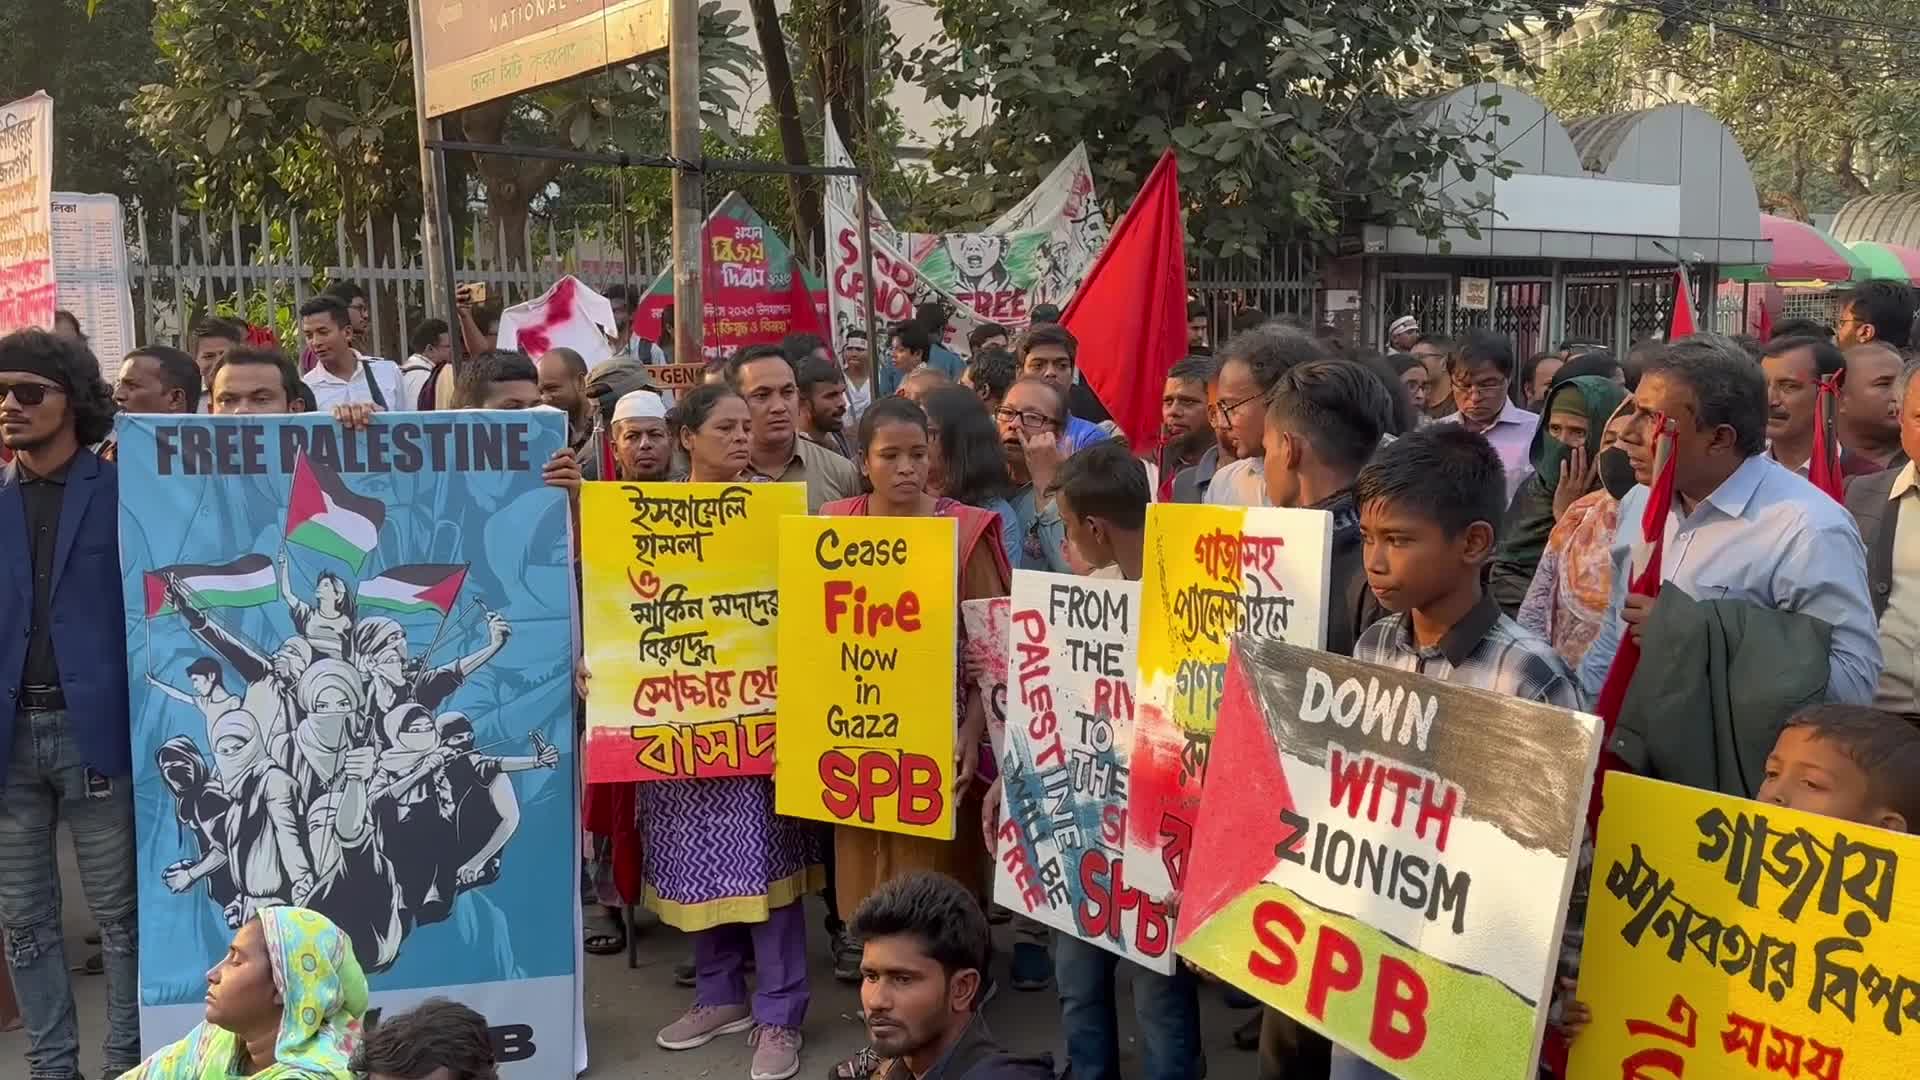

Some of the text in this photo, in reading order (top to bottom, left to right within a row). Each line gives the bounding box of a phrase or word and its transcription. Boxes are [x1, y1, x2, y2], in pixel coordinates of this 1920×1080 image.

[489, 0, 567, 32] NATIONAL
[711, 235, 765, 264] বিজয়
[721, 262, 765, 288] দিবস
[156, 422, 530, 475] FREE PALESTINE
[632, 531, 713, 566] হামলা
[815, 528, 907, 570] Cease
[1194, 527, 1284, 591] গাজাসহ
[627, 566, 661, 599] ও
[824, 580, 921, 638] Fire
[1050, 584, 1128, 634] FROM
[840, 642, 898, 672] Now
[1066, 639, 1124, 677] THE
[855, 675, 880, 705] in
[1299, 667, 1438, 751] DOWN
[827, 705, 898, 739] Gaza
[1013, 608, 1080, 853] PALESTINE
[1075, 712, 1115, 753] TO
[818, 750, 943, 826] SPB
[1072, 752, 1129, 800] THE
[1329, 747, 1459, 853] WITH
[1004, 752, 1072, 910] WILL BE
[999, 817, 1047, 913] FREE
[1274, 808, 1472, 935] ZIONISM
[1696, 808, 1898, 937] গাজায়
[1248, 900, 1429, 1061] SPB
